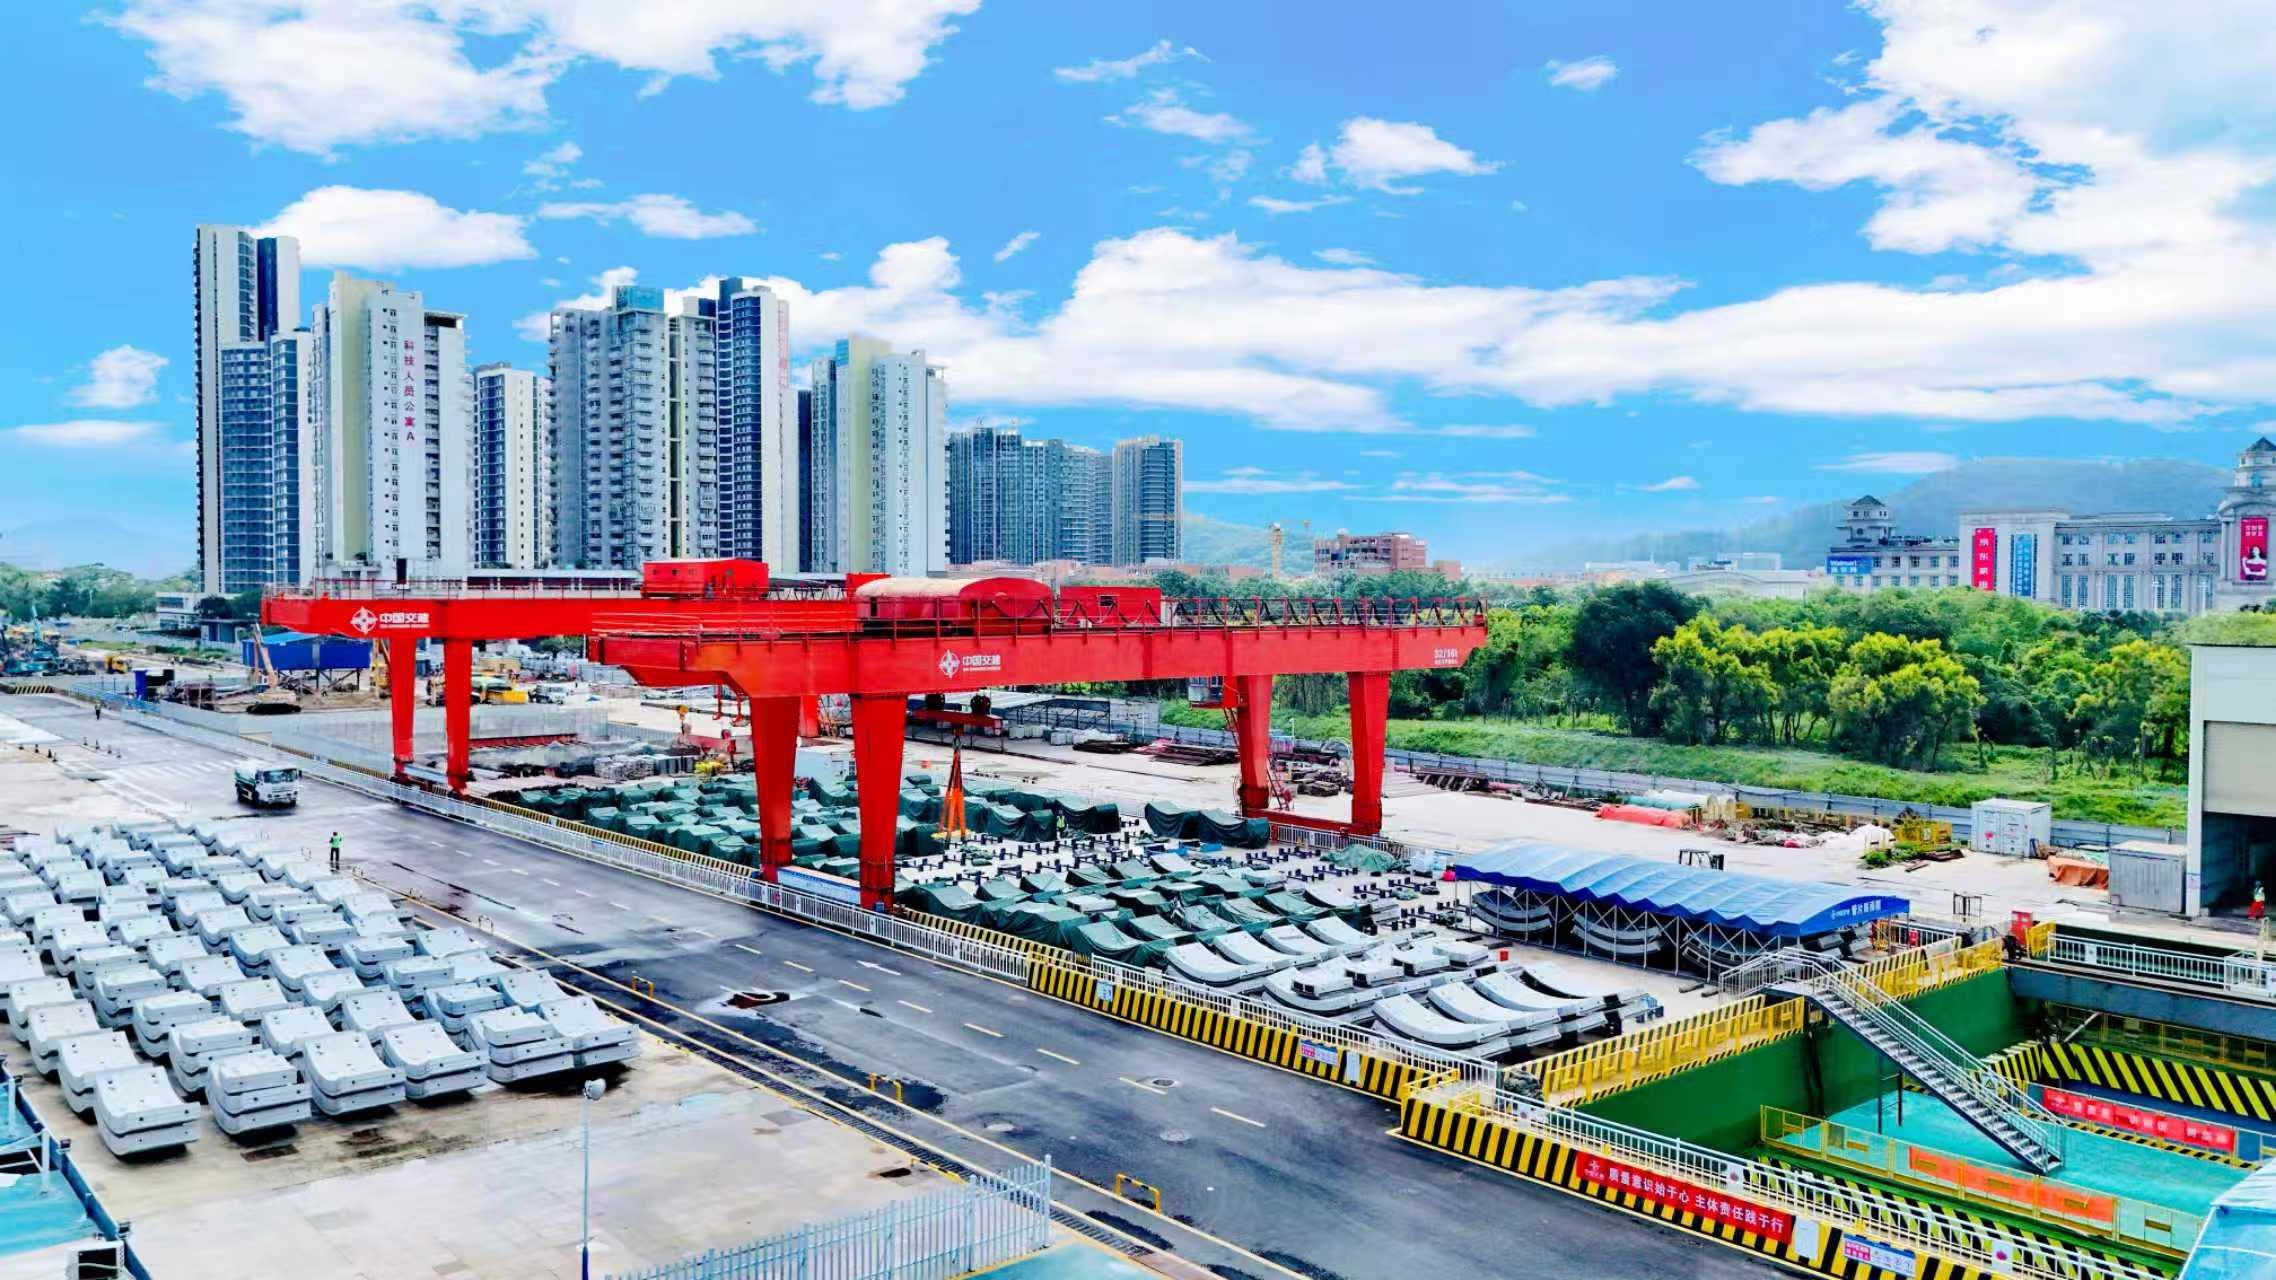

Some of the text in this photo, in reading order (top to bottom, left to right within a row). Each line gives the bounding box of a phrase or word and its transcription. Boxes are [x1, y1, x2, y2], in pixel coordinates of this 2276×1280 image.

[379, 612, 430, 624] 中国交建
[962, 654, 1001, 667] 中国交建
[1608, 1166, 1784, 1234] 质量意识始于心 主体责任践于行
